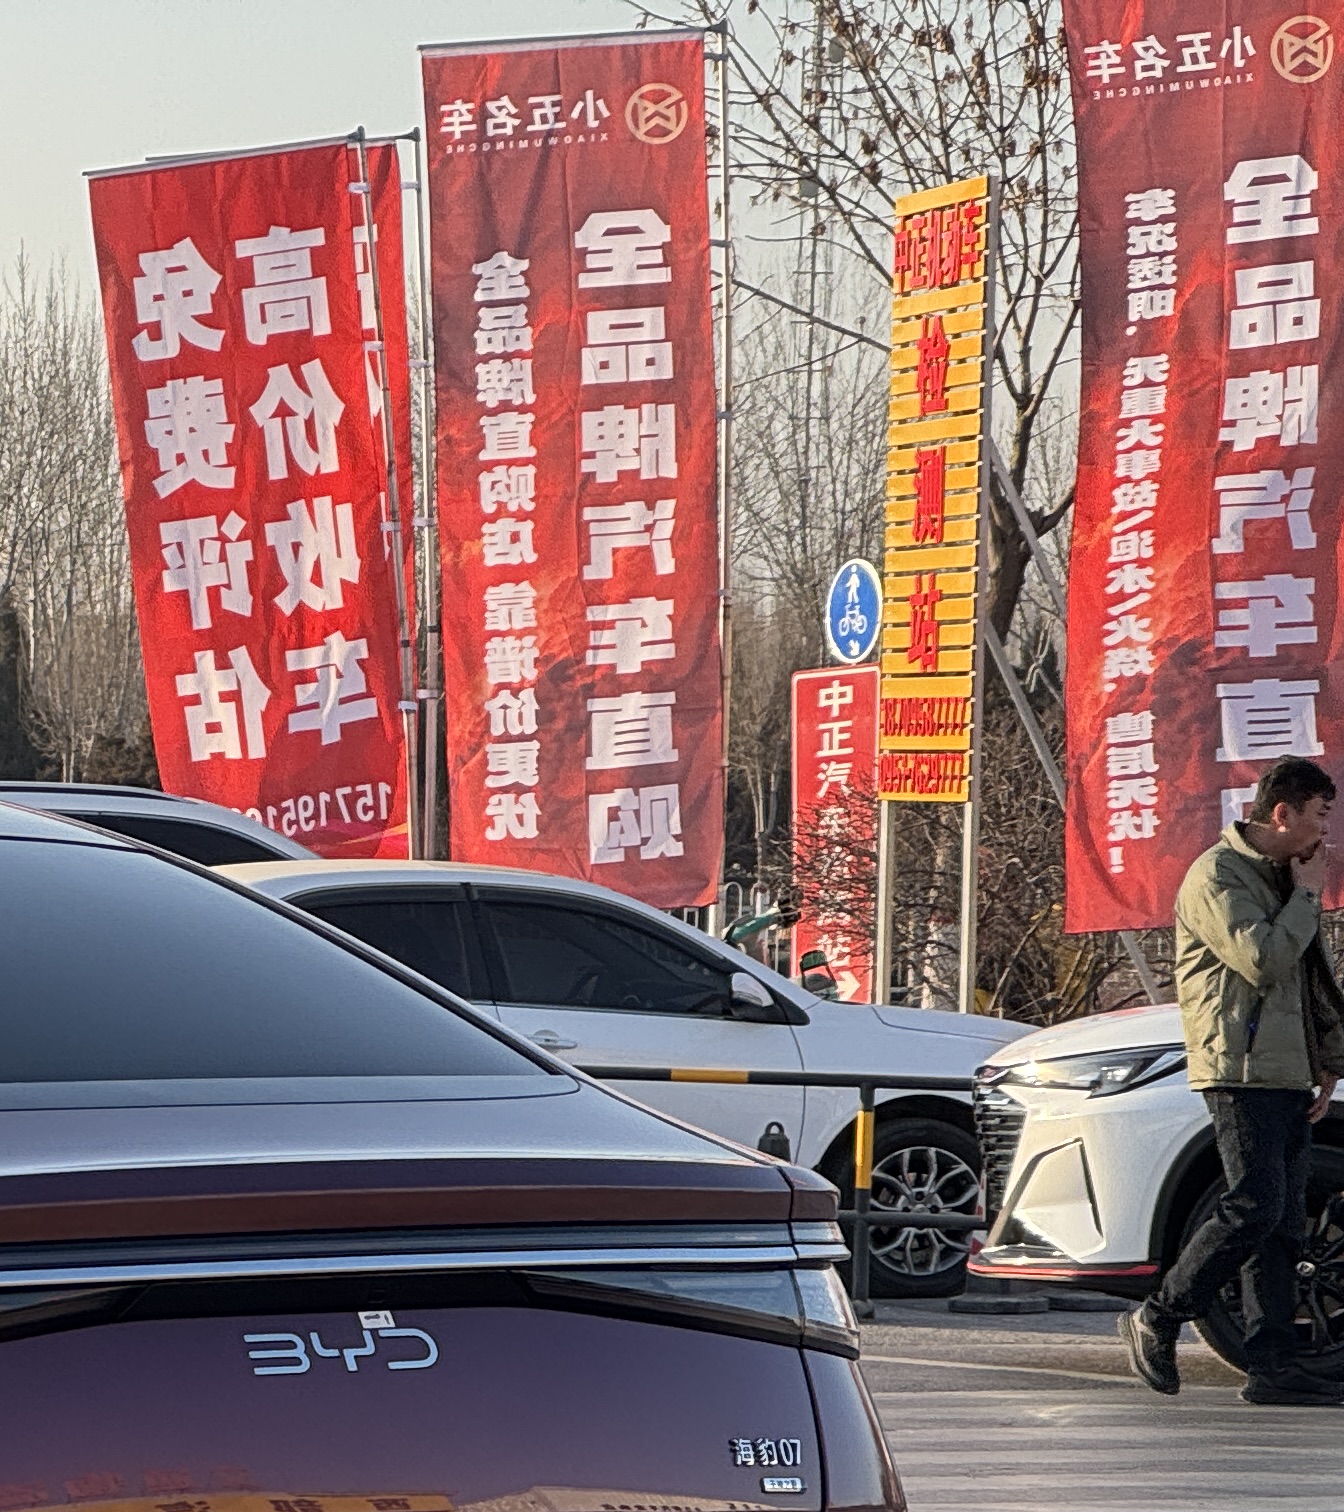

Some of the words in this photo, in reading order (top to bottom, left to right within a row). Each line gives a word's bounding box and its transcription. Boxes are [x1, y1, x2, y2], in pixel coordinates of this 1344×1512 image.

[908, 315, 950, 673] 检测站
[243, 1328, 439, 1376] BYD
[730, 1437, 801, 1466] 海豹07
